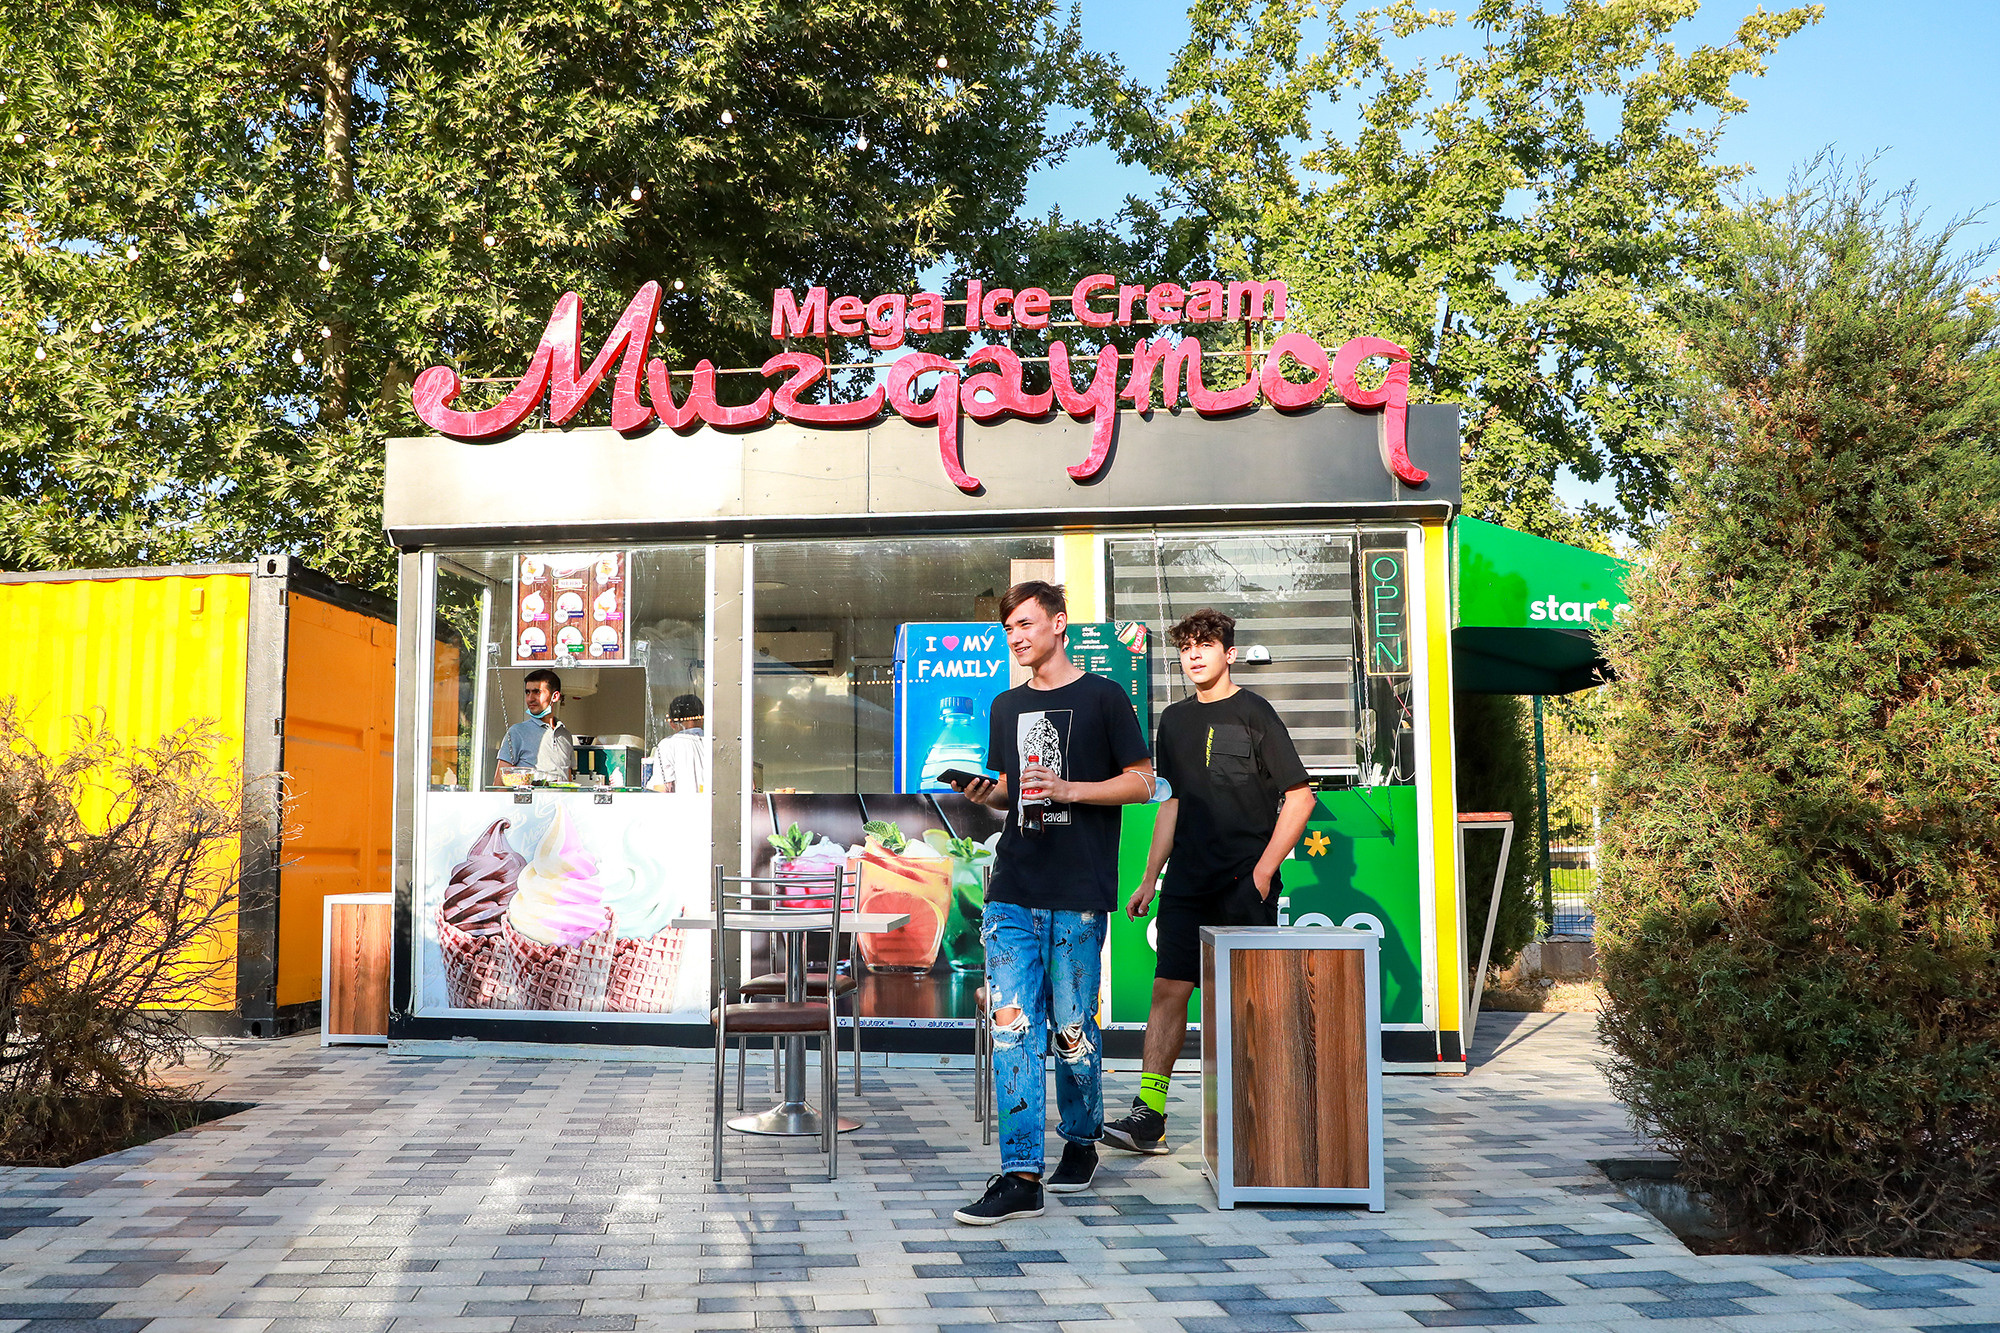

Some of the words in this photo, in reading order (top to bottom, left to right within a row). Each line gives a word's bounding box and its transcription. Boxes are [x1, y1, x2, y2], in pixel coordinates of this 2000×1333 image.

[771, 286, 945, 350] Mega
[965, 279, 1051, 332] Ice
[1072, 273, 1288, 327] Cream
[412, 279, 1430, 492] Muzqaymoq
[1371, 556, 1402, 666] OPEN
[925, 636, 938, 652] I
[963, 635, 995, 652] MY
[918, 659, 1001, 678] FAMILY
[1042, 810, 1068, 823] cavalli
